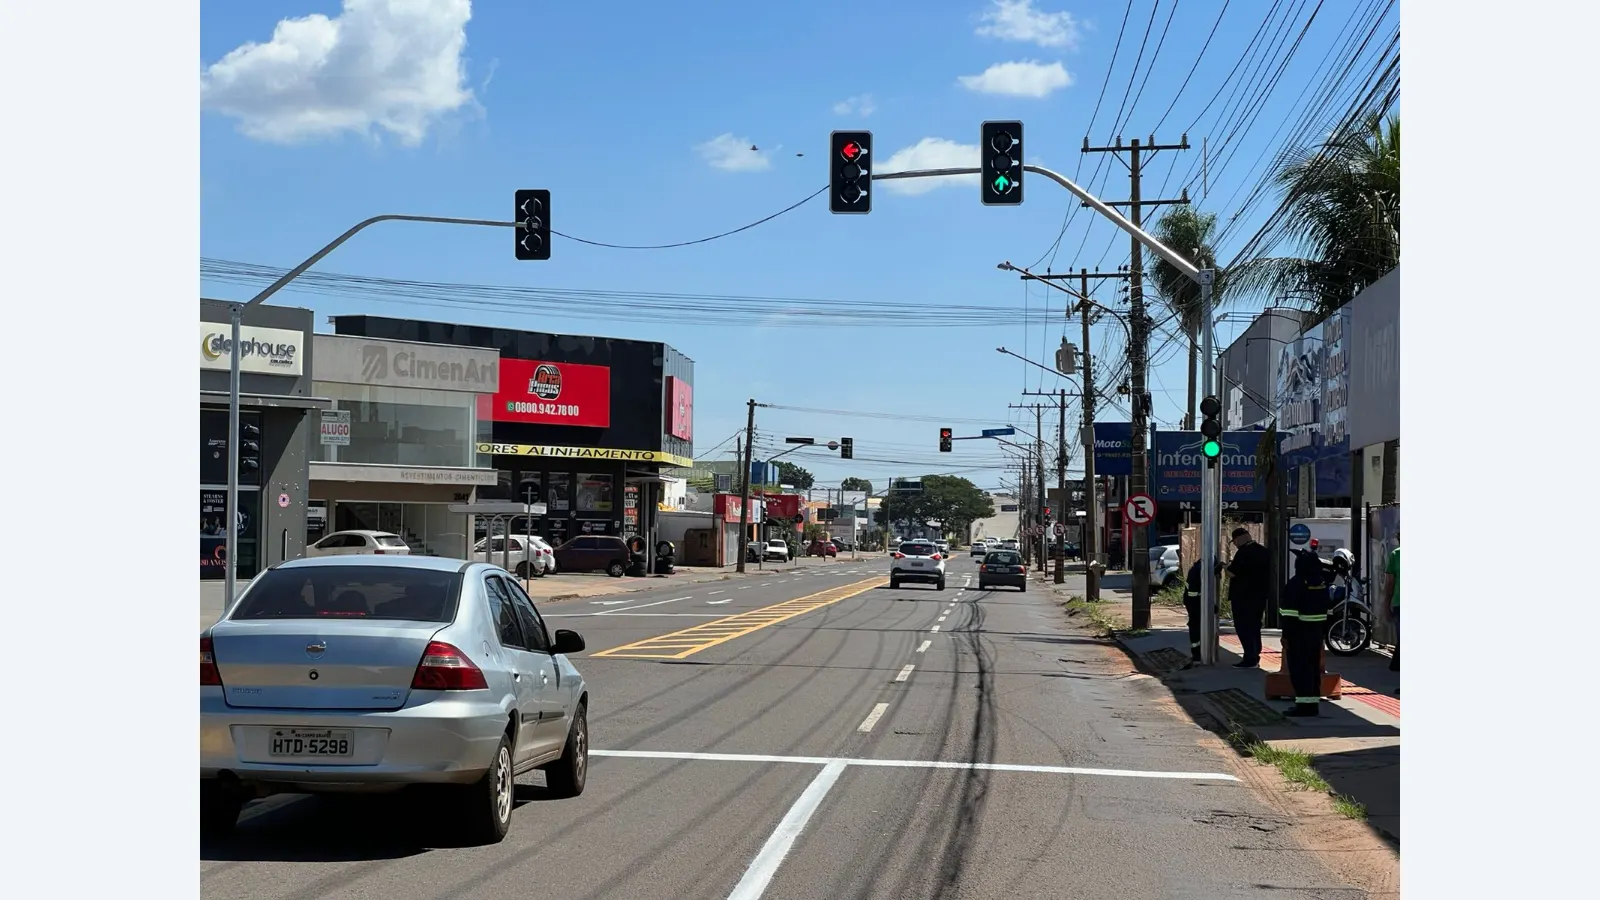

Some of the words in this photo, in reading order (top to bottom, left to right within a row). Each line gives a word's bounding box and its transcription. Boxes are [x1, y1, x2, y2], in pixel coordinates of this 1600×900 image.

[211, 334, 296, 358] slephouse
[393, 351, 497, 383] CimenArt
[515, 401, 579, 416] 0800.942.7800
[321, 423, 349, 436] ALUGO
[477, 444, 519, 454] ORES
[527, 446, 655, 460] ALINHAMENTO
[1180, 501, 1196, 510] N.
